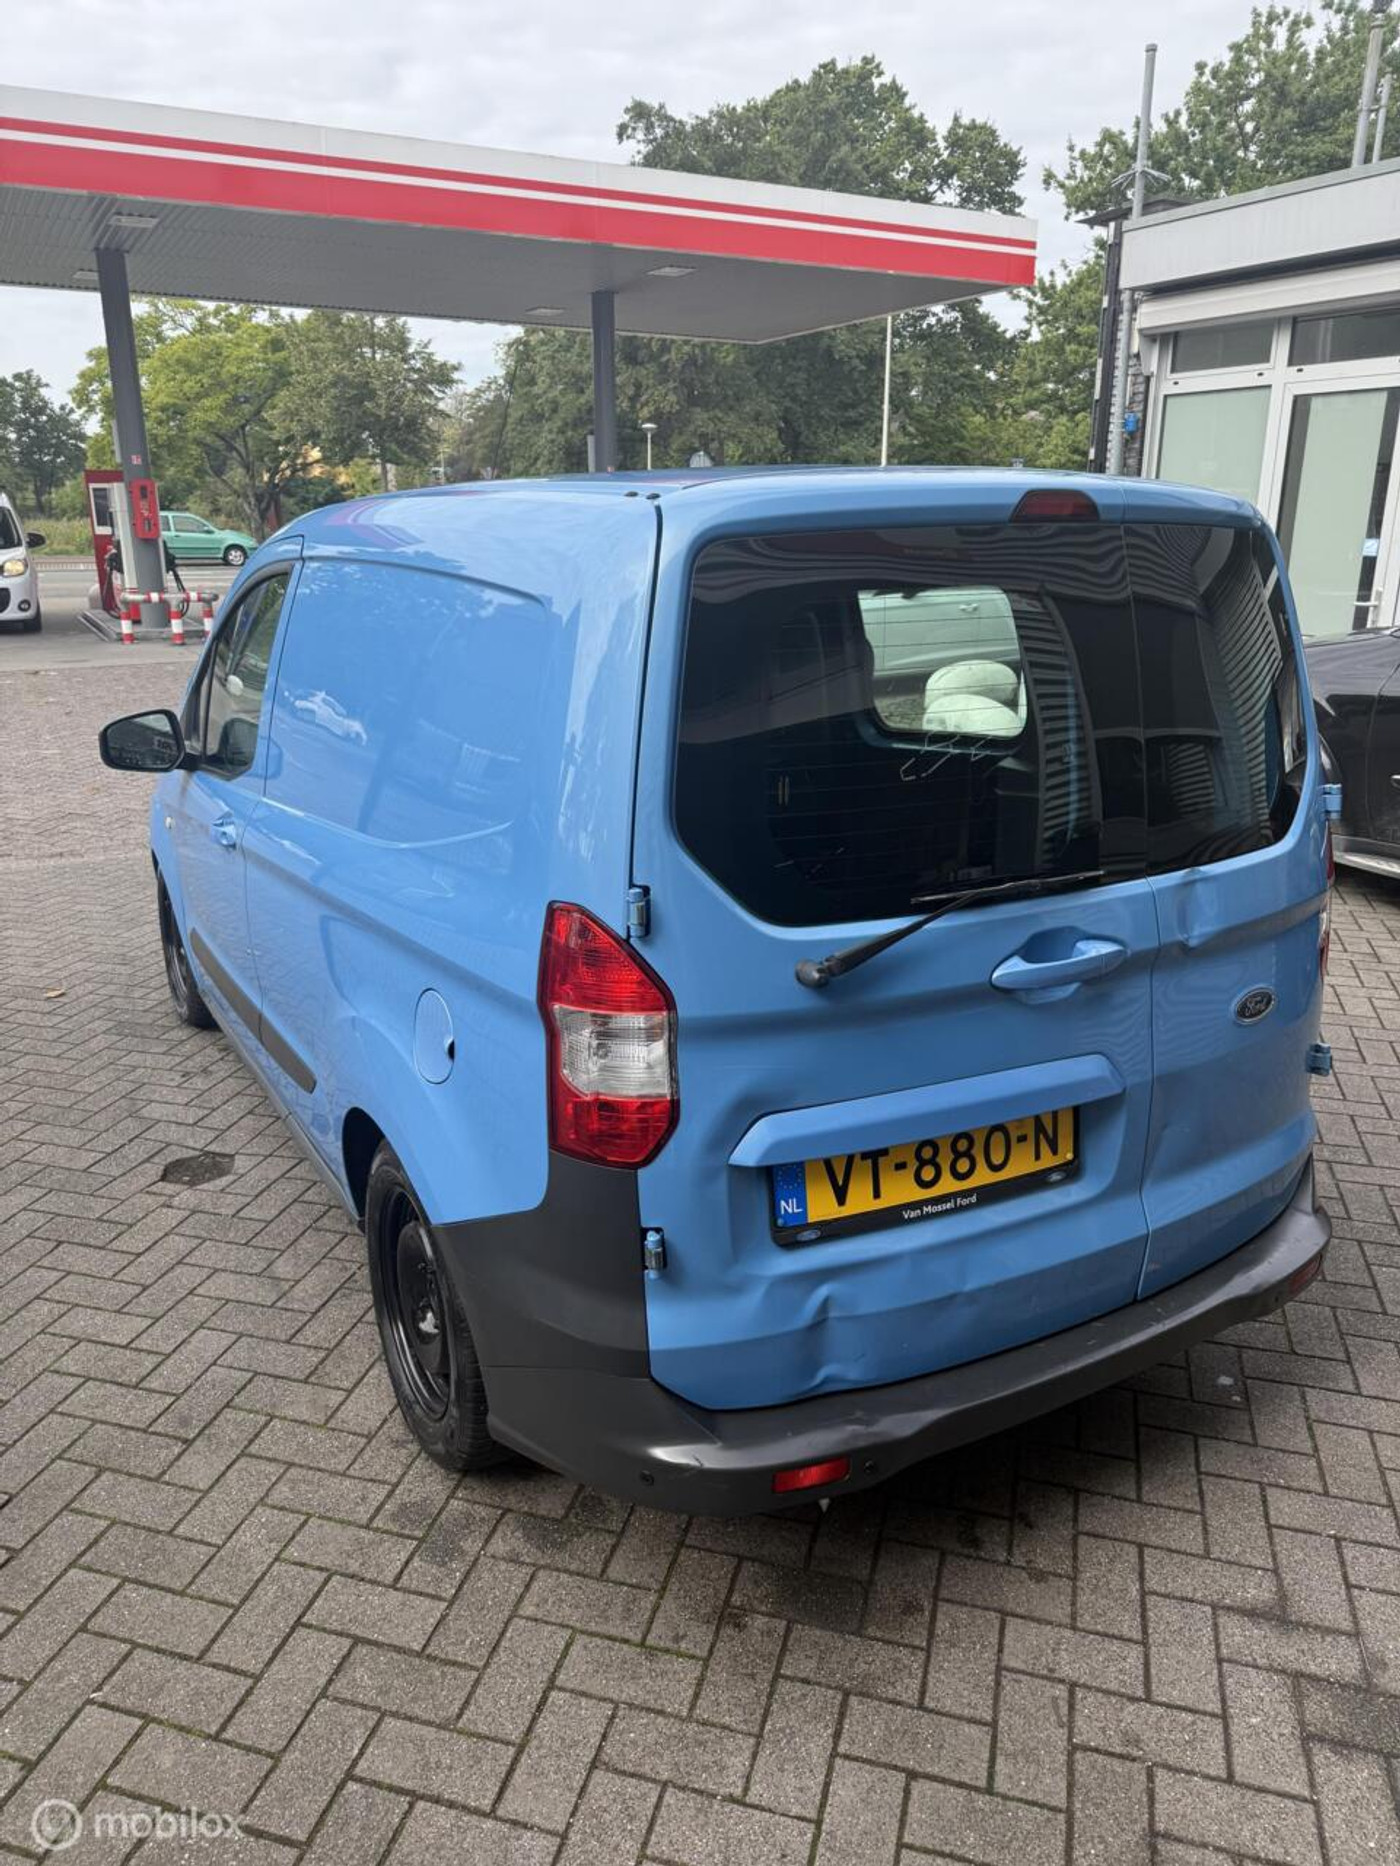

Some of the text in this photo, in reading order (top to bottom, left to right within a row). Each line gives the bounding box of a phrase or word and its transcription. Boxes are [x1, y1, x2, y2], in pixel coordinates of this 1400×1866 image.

[823, 1108, 1059, 1207] VT-880-N
[780, 1199, 803, 1215] NL
[902, 1192, 977, 1219] Van Mossel Ford
